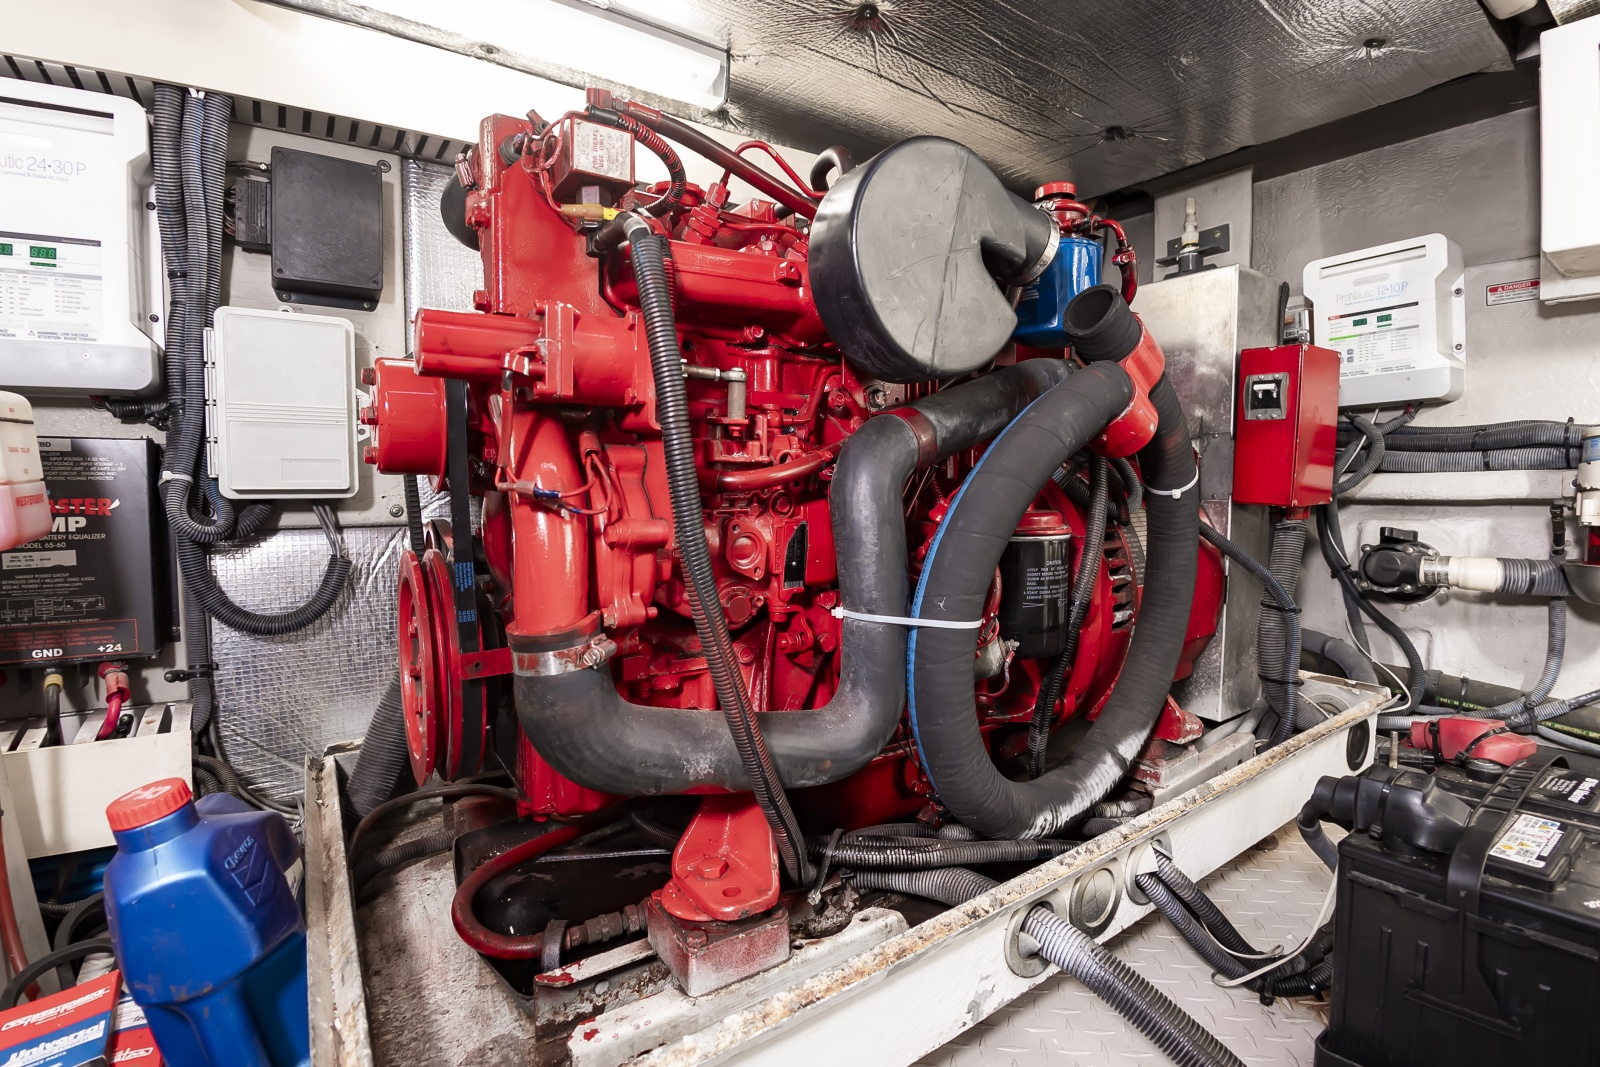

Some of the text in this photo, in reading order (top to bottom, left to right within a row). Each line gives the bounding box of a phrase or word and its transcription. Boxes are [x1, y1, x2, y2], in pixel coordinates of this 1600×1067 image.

[77, 162, 87, 176] P
[1336, 289, 1375, 304] ProNautic
[1401, 281, 1408, 292] P
[1503, 282, 1532, 291] DANGER
[32, 648, 64, 658] GND
[97, 643, 123, 653] +24
[1555, 722, 1588, 735] PREMIUM
[9, 1019, 105, 1062] Universal
[46, 1051, 67, 1062] PARTS
